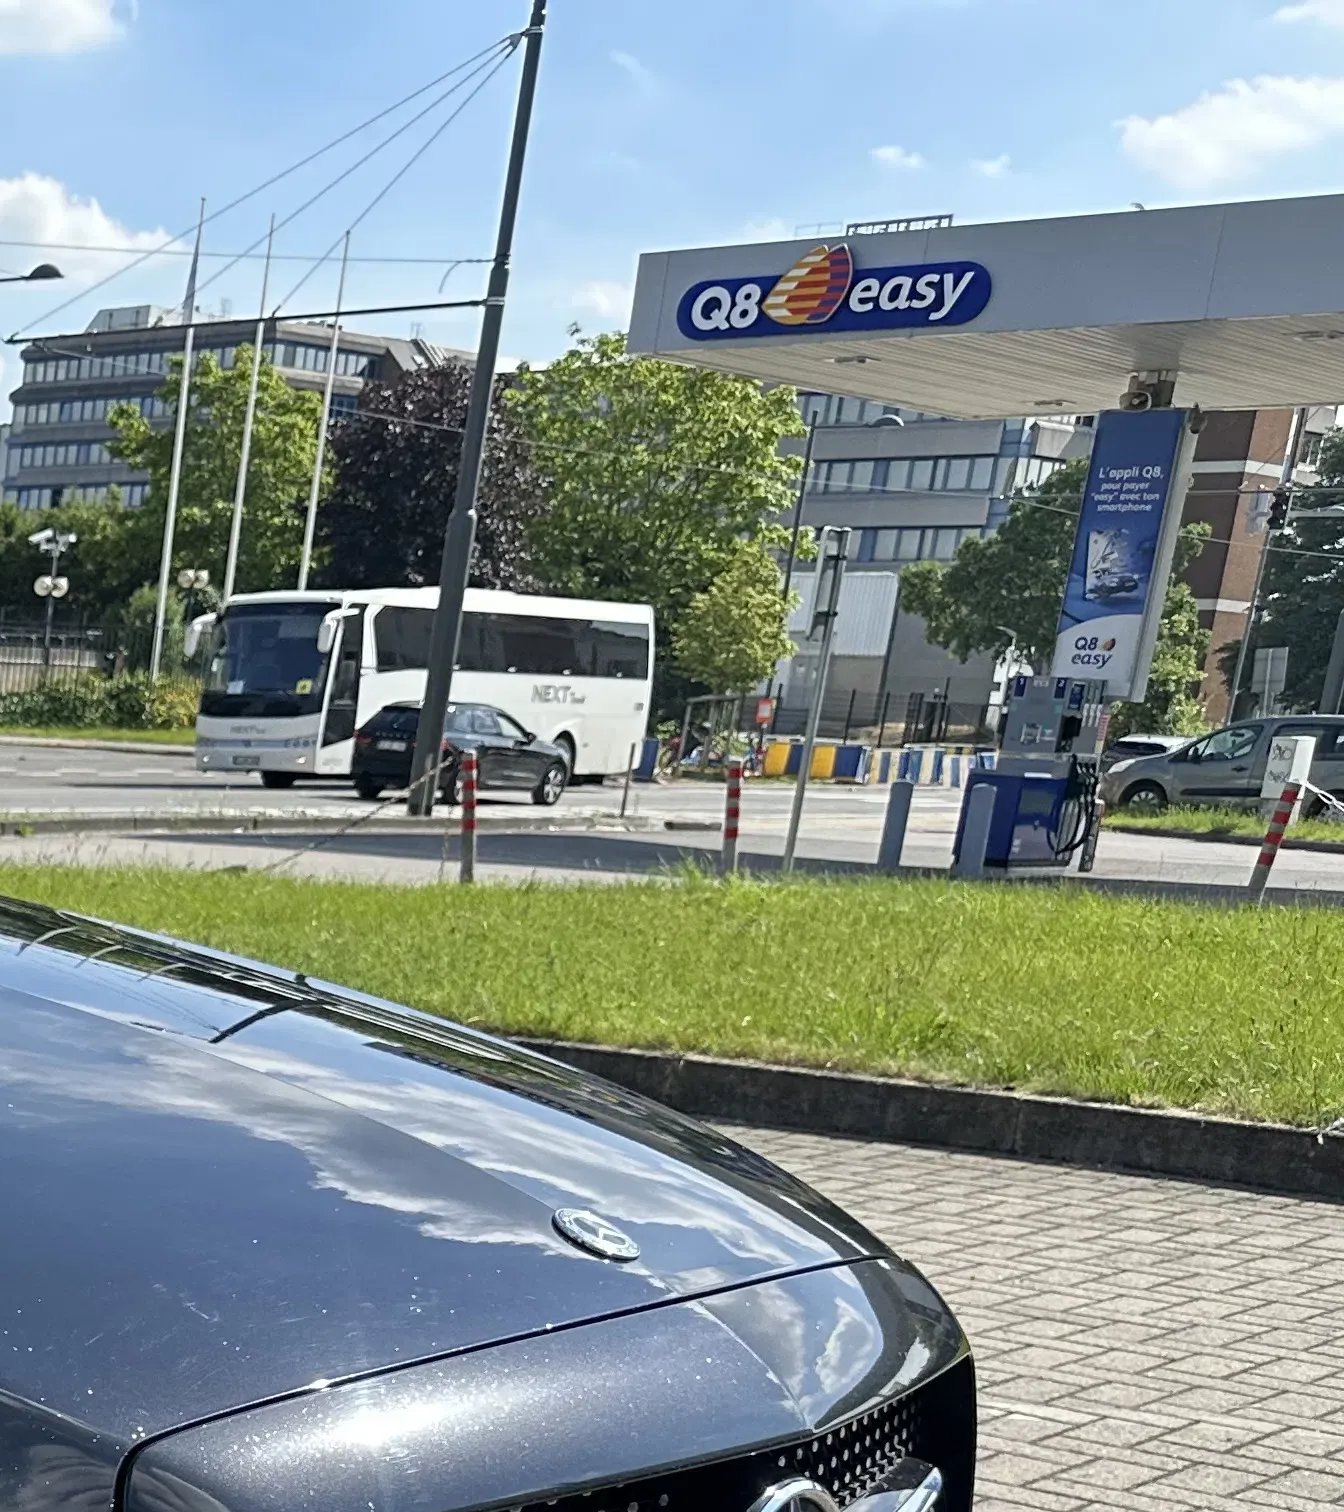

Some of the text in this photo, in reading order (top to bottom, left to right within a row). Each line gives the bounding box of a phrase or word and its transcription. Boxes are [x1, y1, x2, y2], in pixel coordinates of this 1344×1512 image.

[690, 270, 975, 331] Q8 easy
[1099, 465, 1164, 480] L'appli Q8,
[1100, 482, 1150, 492] pour payer
[1143, 492, 1160, 500] ton
[1097, 502, 1152, 512] smartphone
[1074, 636, 1099, 651] Q8
[1071, 653, 1113, 669] easy
[531, 684, 571, 703] NEXT
